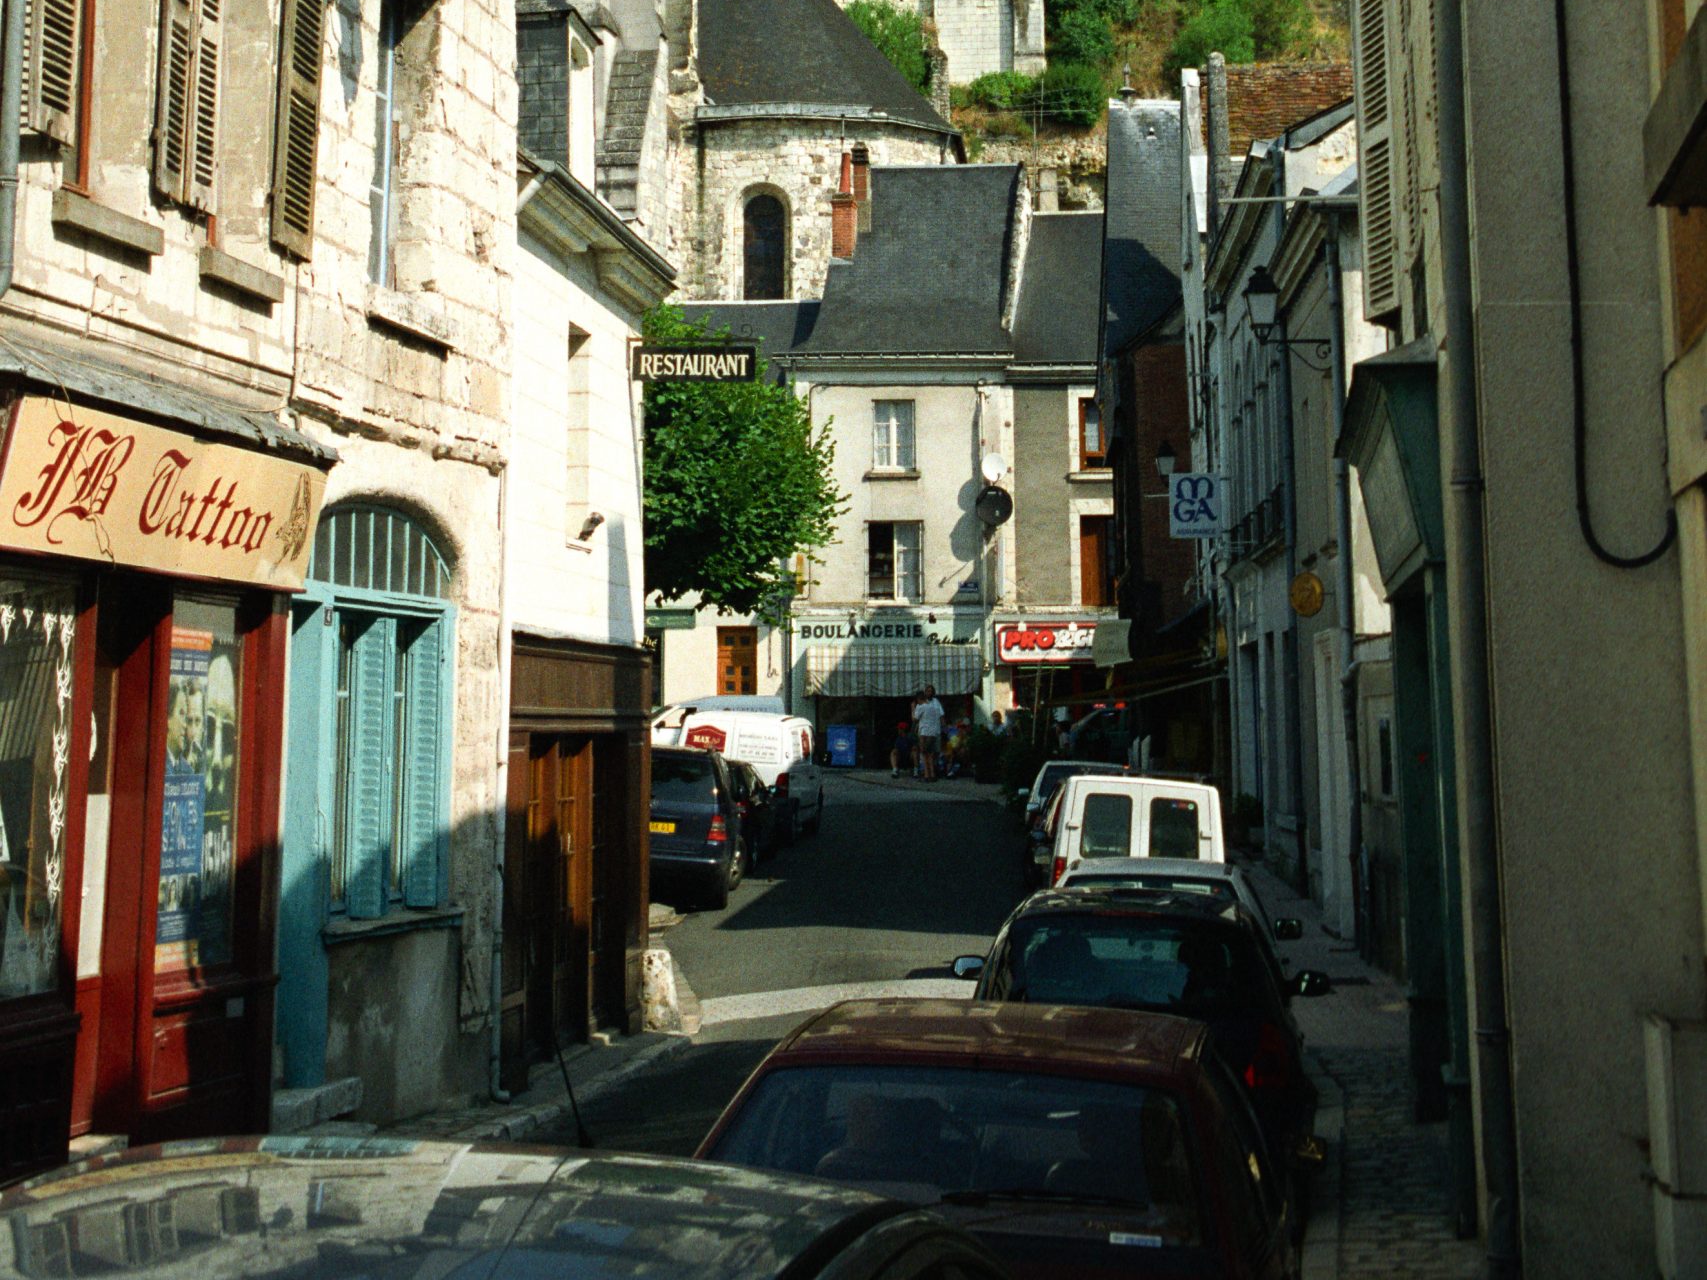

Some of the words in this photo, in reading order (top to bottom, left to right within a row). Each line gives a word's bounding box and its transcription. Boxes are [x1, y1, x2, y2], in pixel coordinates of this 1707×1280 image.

[640, 353, 750, 379] RESTAURANT
[12, 420, 136, 545] JB
[138, 449, 275, 554] Tattoo
[800, 623, 924, 639] BOULANGERIE
